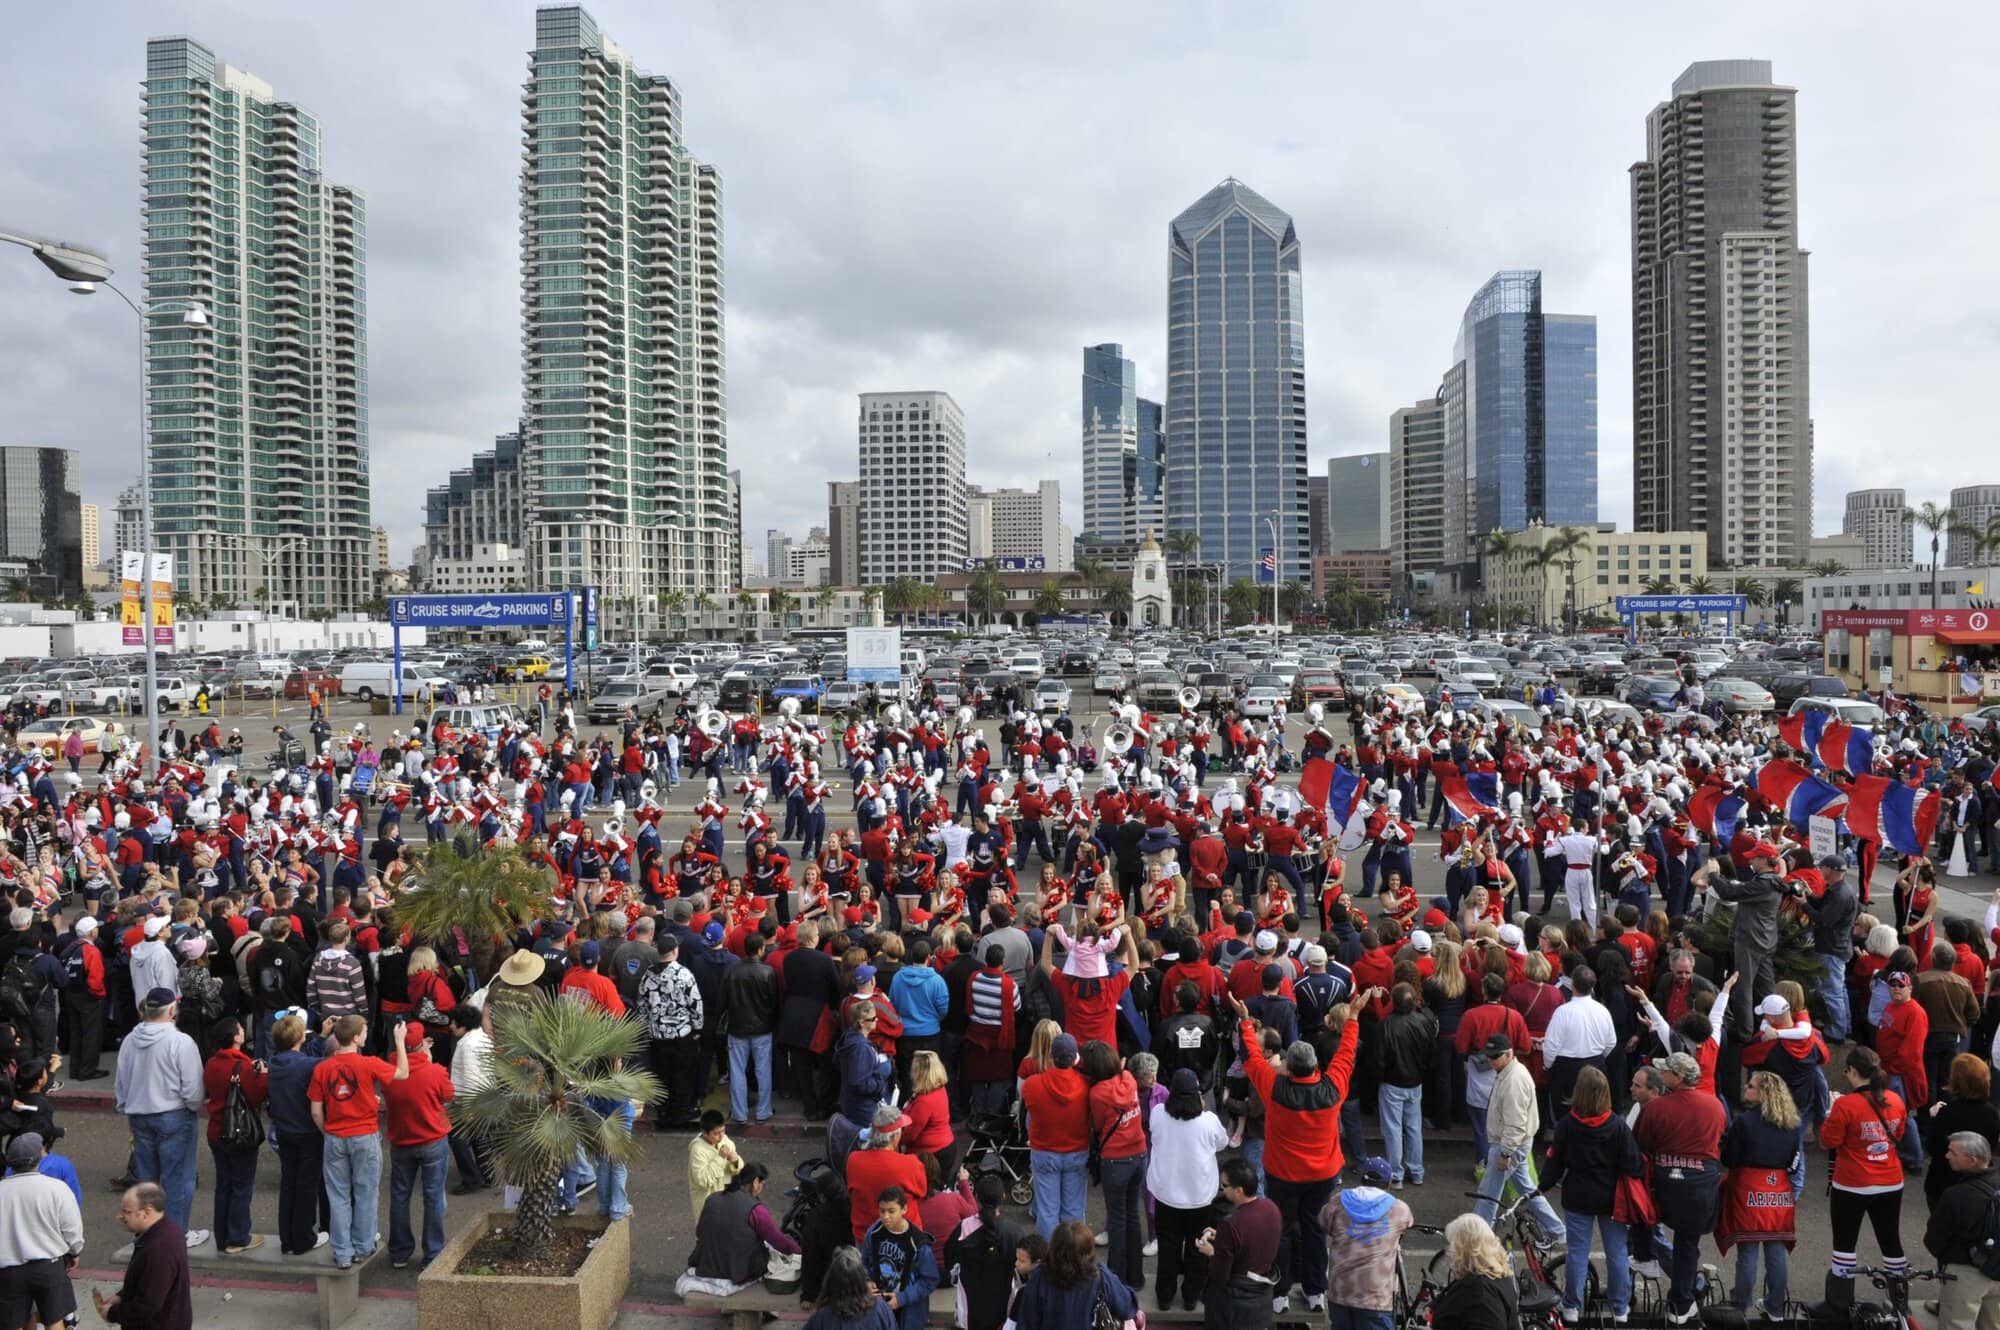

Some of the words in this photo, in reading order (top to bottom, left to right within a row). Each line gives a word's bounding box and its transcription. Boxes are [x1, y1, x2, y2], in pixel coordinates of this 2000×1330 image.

[965, 558, 1015, 570] Sata
[1025, 558, 1042, 569] Fe
[553, 599, 563, 611] 5
[589, 589, 595, 611] 5
[1630, 600, 1658, 608] CRUISE
[397, 602, 406, 614] 5
[411, 605, 449, 617] CRUISE
[450, 605, 474, 616] SHIP
[503, 603, 548, 616] PARKING
[1623, 614, 1630, 623] P
[1844, 617, 1865, 625] VISITOR
[1866, 617, 1904, 626] INFORMATION
[589, 630, 596, 648] P
